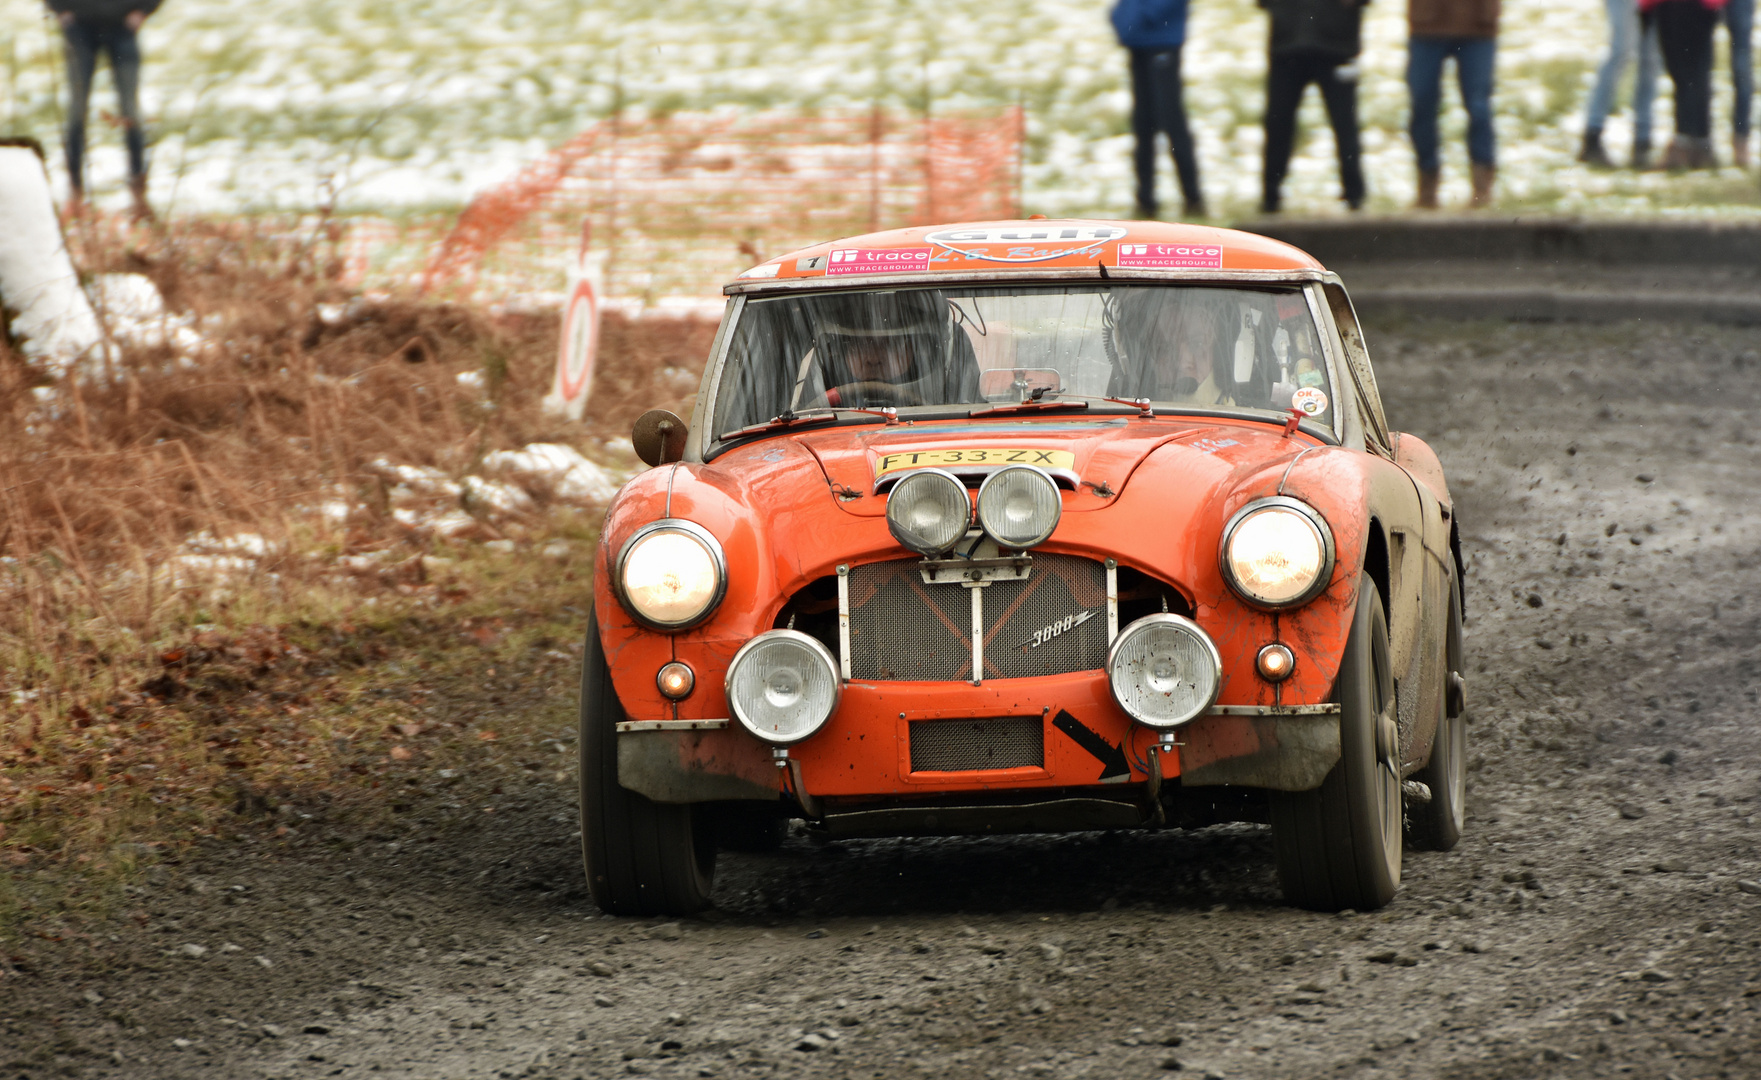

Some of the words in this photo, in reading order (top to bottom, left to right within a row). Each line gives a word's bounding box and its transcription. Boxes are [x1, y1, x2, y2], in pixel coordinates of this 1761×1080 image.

[865, 251, 928, 261] trace
[1007, 246, 1106, 260] Racing
[1156, 245, 1219, 256] trace
[829, 264, 927, 273] WWW.TRACEGROUP.BE
[1297, 390, 1312, 398] OK
[882, 450, 1054, 470] FT-33-ZX
[1032, 615, 1073, 648] 3000
